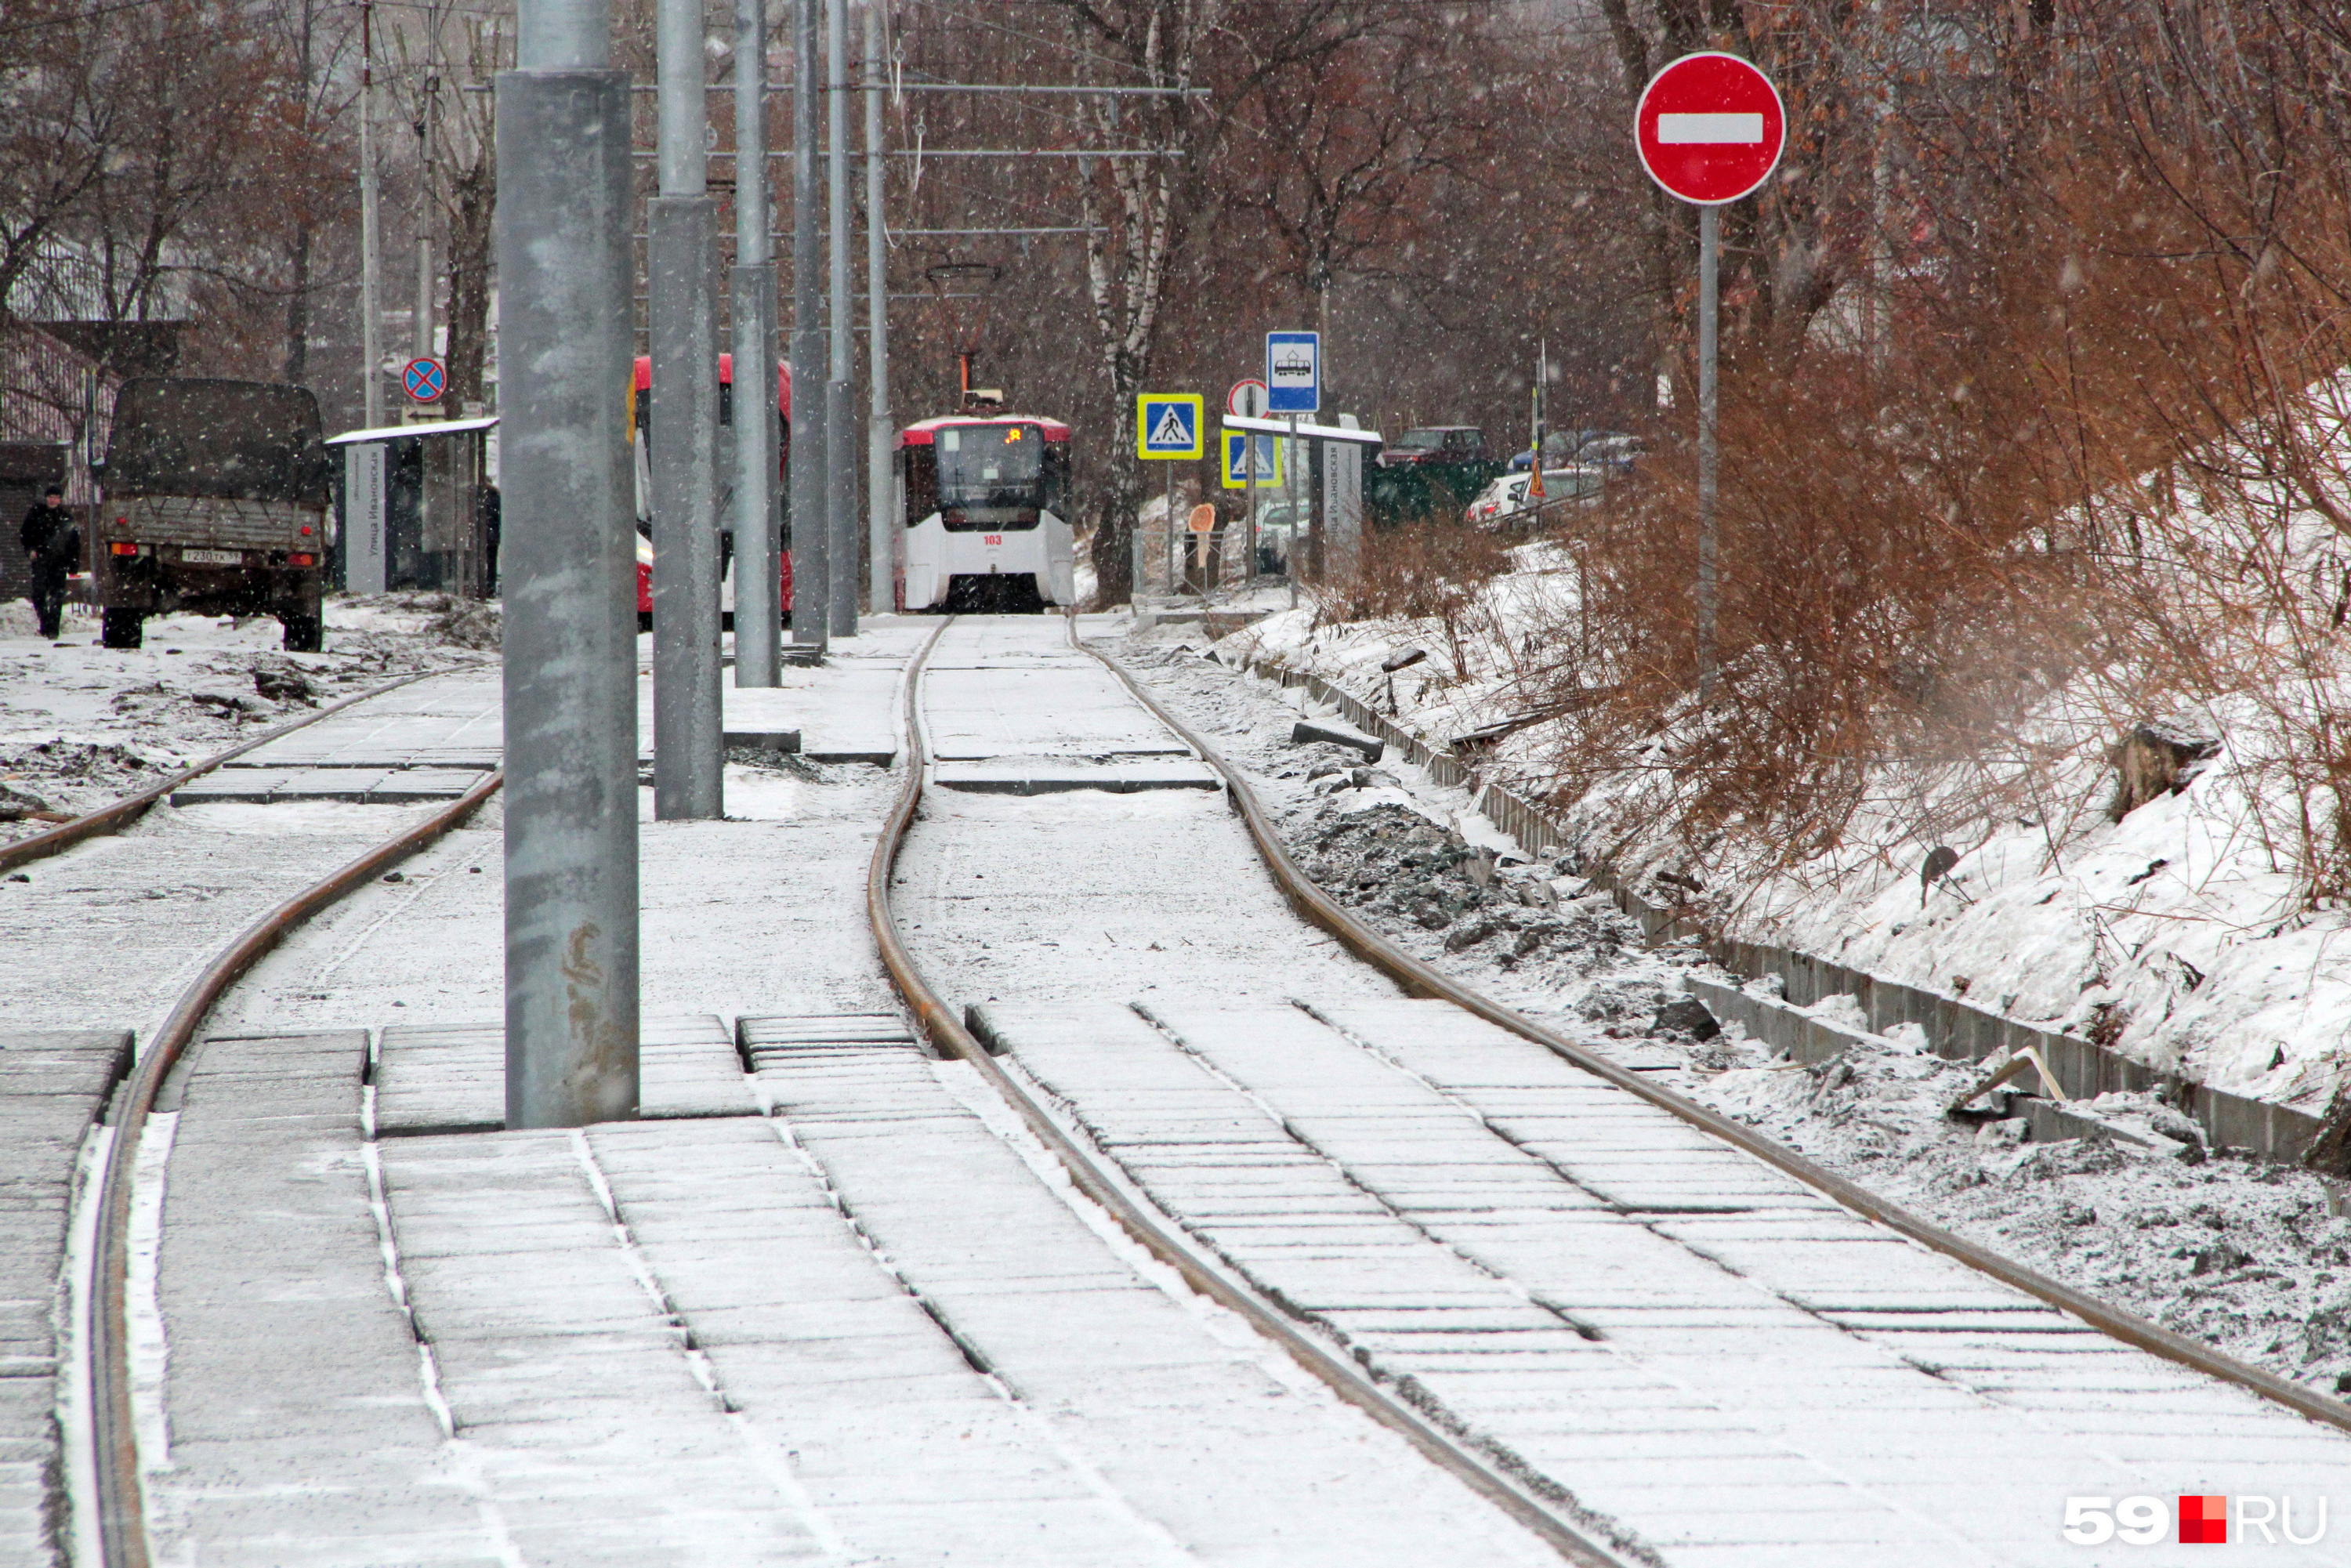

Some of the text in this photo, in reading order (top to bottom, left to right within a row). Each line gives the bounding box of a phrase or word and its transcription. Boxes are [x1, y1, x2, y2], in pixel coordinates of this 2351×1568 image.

[368, 451, 379, 556] Улица Ивановская
[984, 534, 1002, 545] 103
